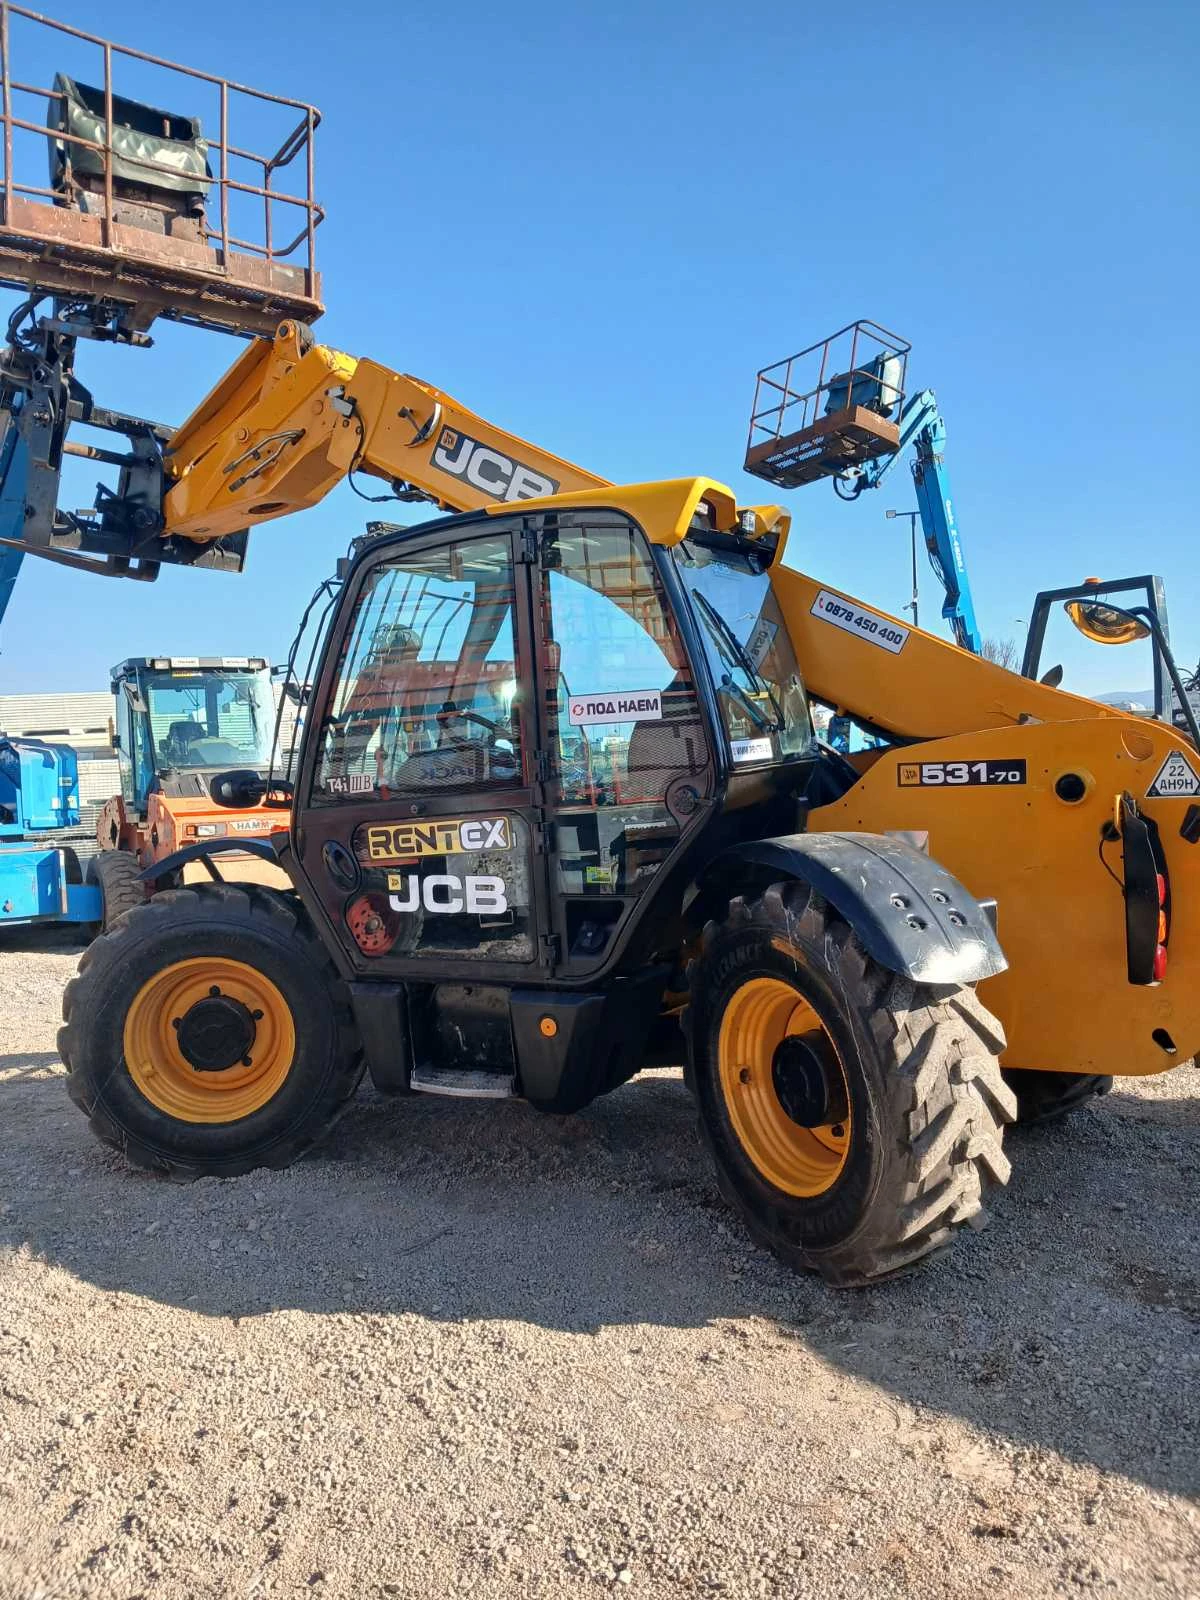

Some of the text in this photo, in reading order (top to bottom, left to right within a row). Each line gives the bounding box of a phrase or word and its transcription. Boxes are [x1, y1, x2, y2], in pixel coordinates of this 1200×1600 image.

[434, 438, 554, 501] JCB
[825, 601, 904, 645] 0878 450 400
[586, 698, 659, 715] ПОД НАЕМ
[921, 762, 1021, 784] 531-70
[1168, 765, 1185, 777] 22
[326, 777, 349, 792] T4i
[1159, 778, 1194, 791] AH9H
[370, 819, 507, 856] RENTEX
[388, 874, 508, 914] JCB
